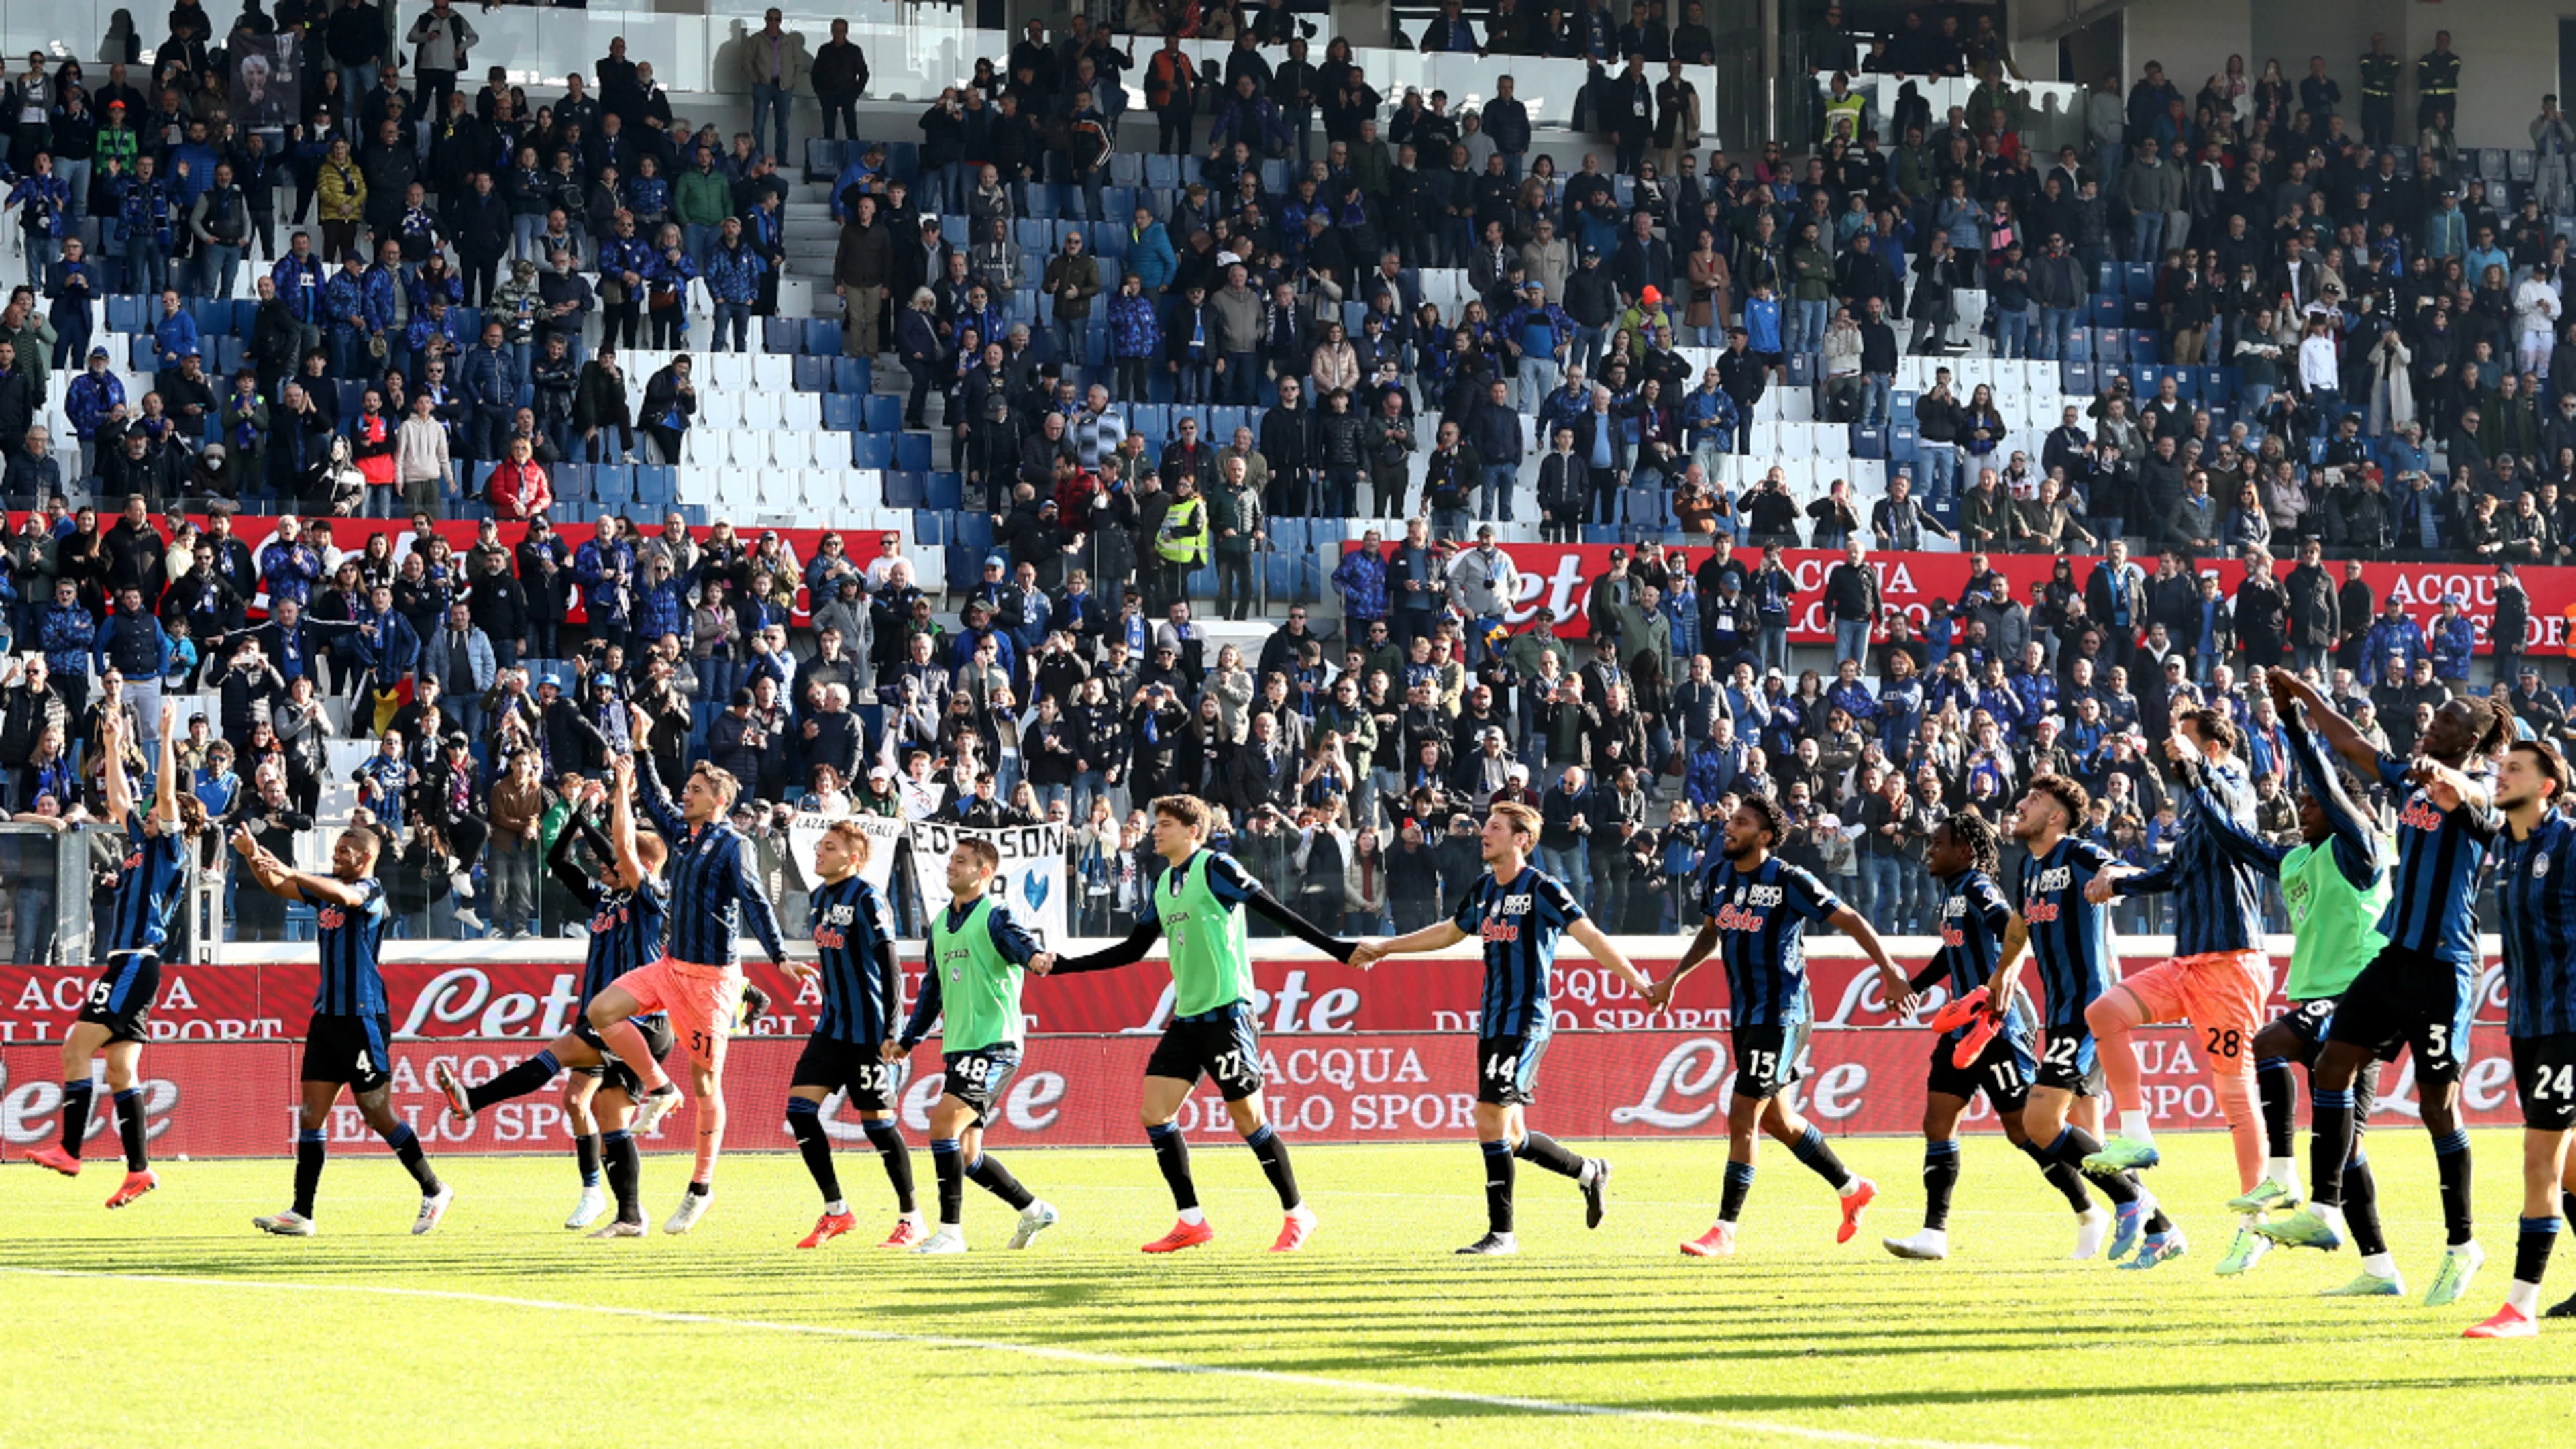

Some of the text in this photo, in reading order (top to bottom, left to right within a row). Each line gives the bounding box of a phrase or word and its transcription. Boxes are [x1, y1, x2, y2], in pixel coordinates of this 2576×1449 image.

[691, 1030, 712, 1058] 31
[2206, 1027, 2240, 1058] 28
[2426, 1024, 2447, 1057] 3
[356, 1049, 371, 1074] 4
[955, 1055, 988, 1081] 48
[1215, 1050, 1241, 1080] 27
[1750, 1049, 1776, 1079] 13
[1990, 1060, 2020, 1091] 11
[860, 1065, 887, 1091] 32
[2534, 1064, 2574, 1099] 24
